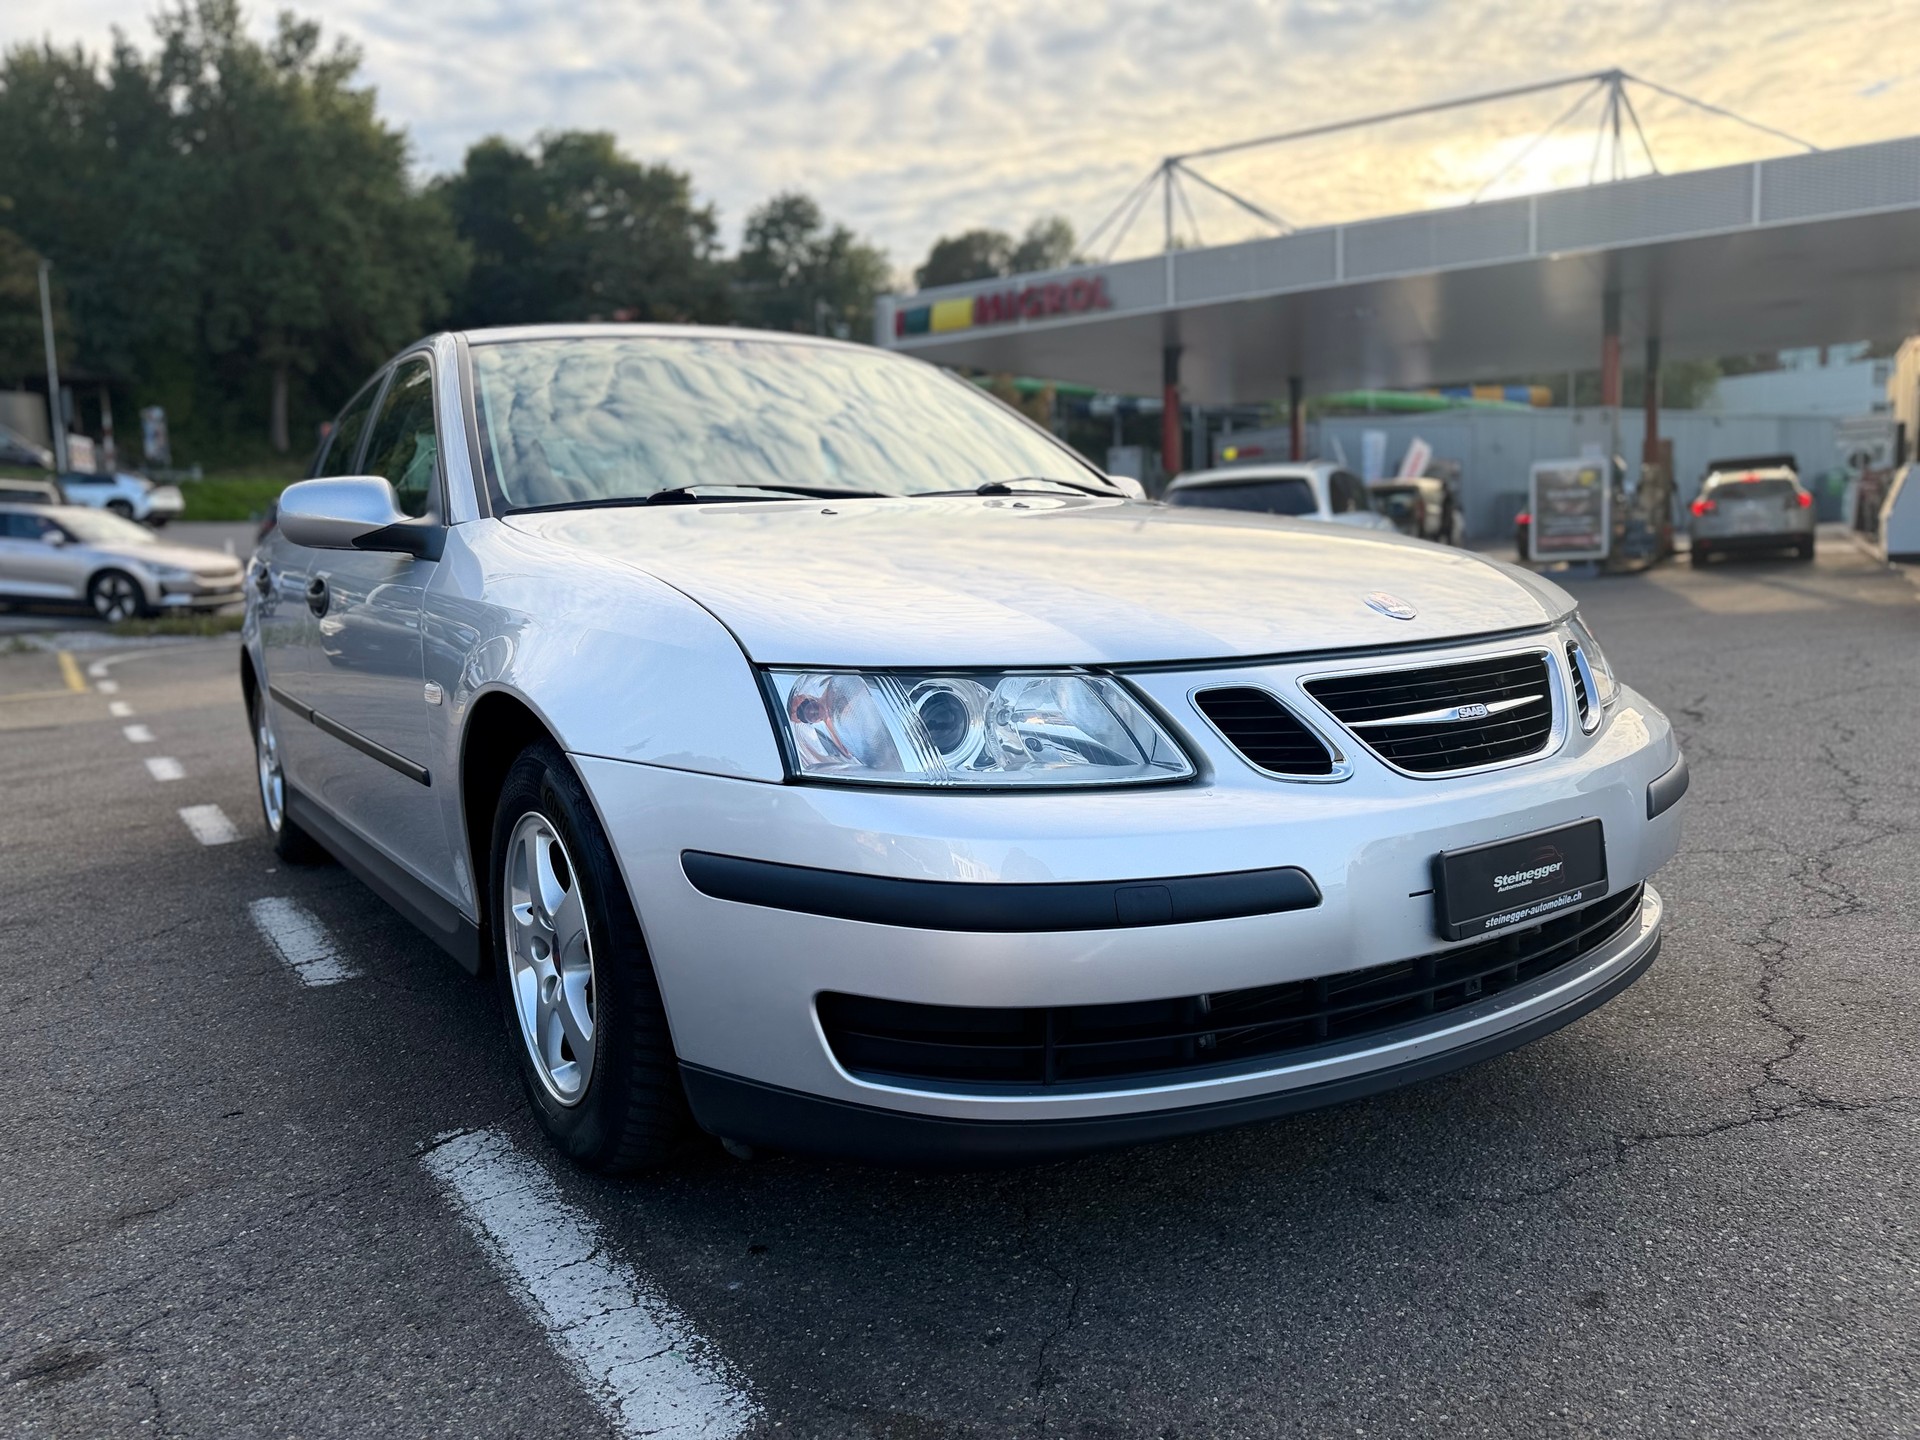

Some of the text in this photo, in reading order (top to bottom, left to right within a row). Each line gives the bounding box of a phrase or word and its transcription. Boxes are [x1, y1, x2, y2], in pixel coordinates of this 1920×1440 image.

[974, 274, 1112, 325] MIGROL
[1459, 705, 1485, 718] SAAB
[1493, 861, 1563, 888] Steinegger
[1497, 879, 1533, 893] Automobile
[1484, 890, 1582, 928] steinegger-automobile.ch
